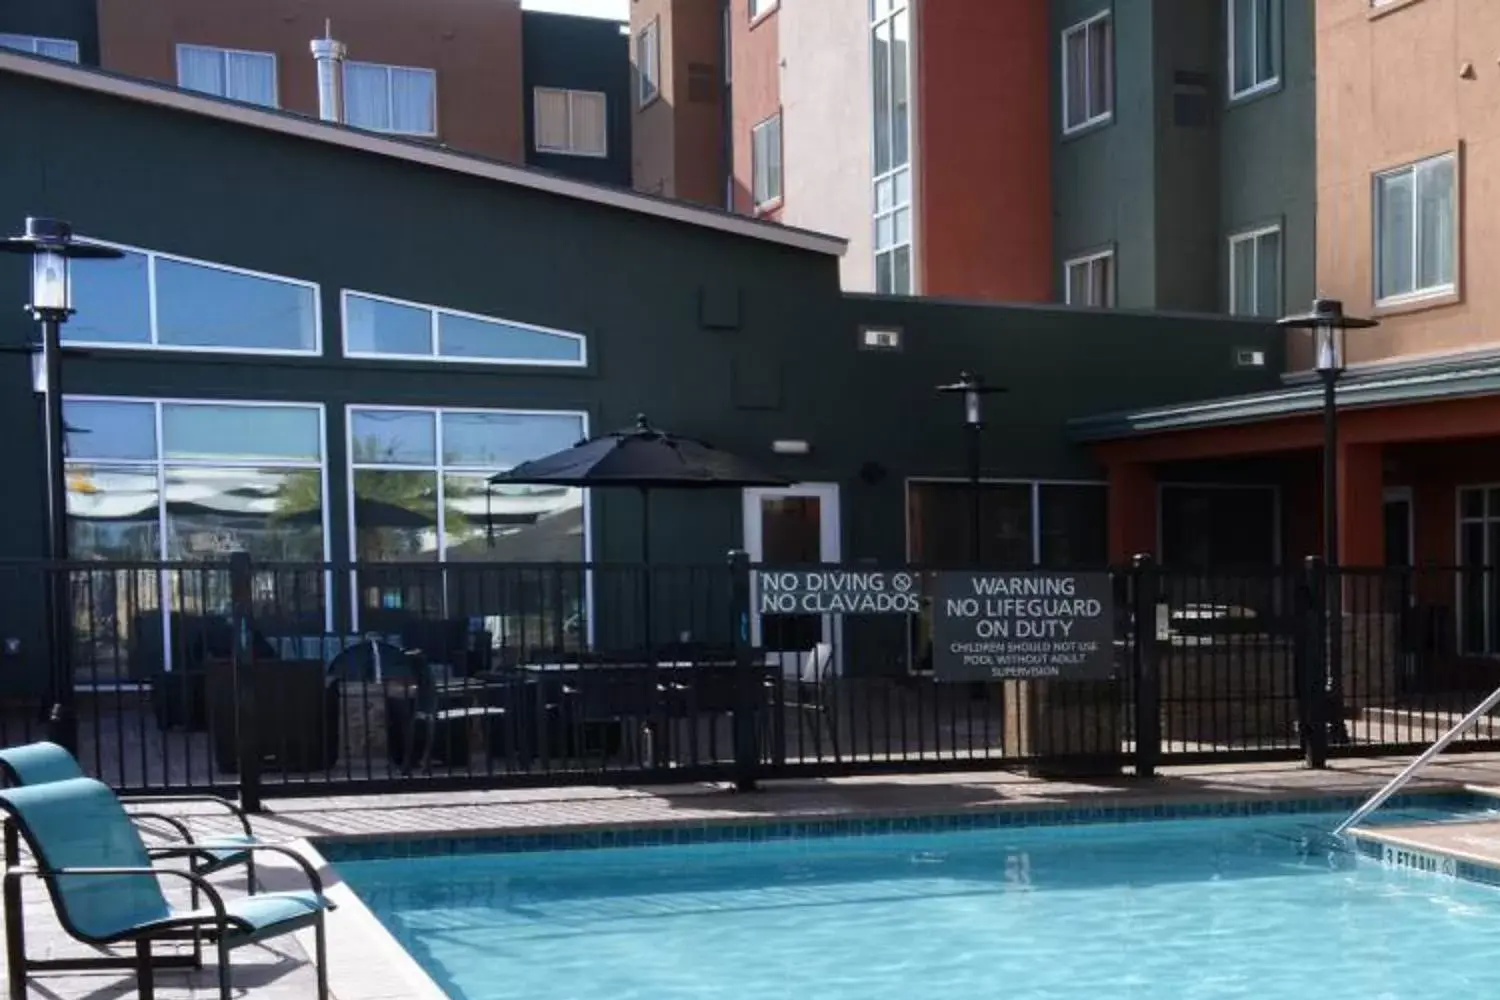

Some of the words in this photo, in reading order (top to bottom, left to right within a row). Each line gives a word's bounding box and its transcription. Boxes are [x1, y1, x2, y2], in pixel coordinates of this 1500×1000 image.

[762, 573, 799, 591] NO
[806, 573, 885, 591] DIVING
[972, 577, 1075, 596] WARNING
[761, 594, 797, 612] NO
[802, 593, 920, 612] CLAVADOS
[947, 599, 979, 617] NO
[987, 599, 1101, 617] LIFEGUARD
[976, 620, 1008, 637] ON
[1016, 620, 1073, 637] DUTY
[950, 642, 1004, 653] CHILDREN
[1008, 641, 1051, 653] SHOULD
[1054, 641, 1077, 652] NOT
[963, 655, 993, 666] POOL
[998, 654, 1049, 665] WITHOUT
[1051, 653, 1087, 664] ADULT
[991, 666, 1060, 678] SUPERVISION
